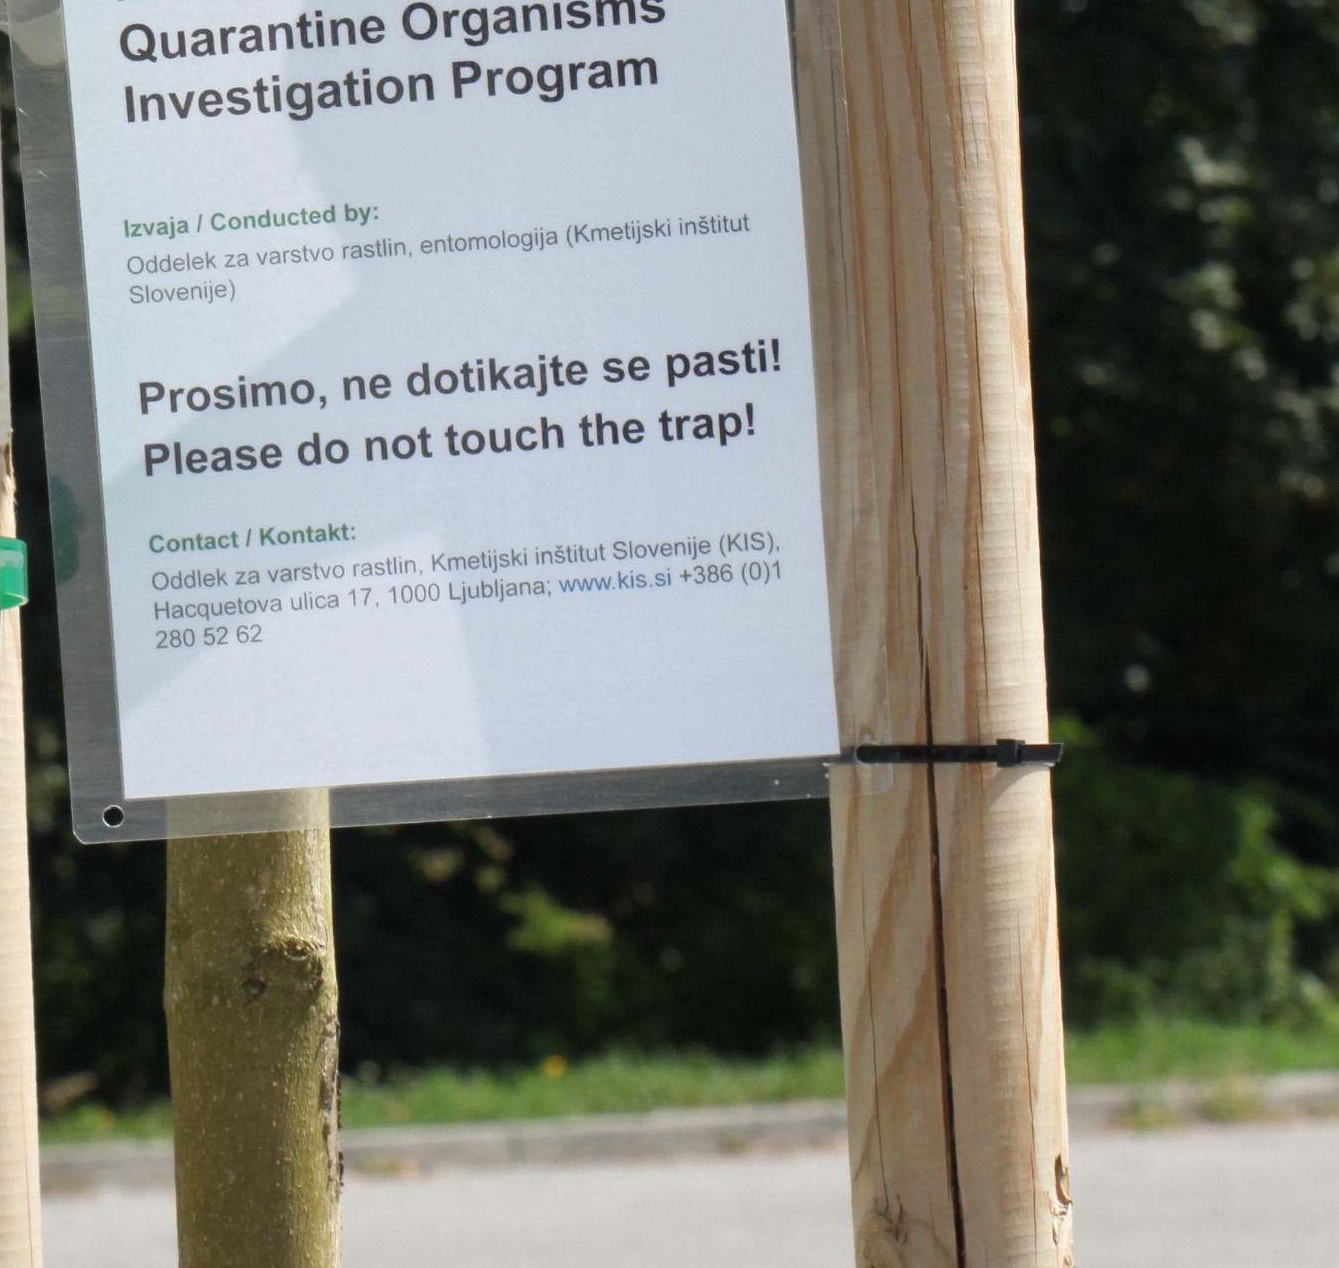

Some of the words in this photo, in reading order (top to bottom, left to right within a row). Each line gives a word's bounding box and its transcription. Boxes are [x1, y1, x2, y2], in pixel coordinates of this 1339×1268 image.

[119, 10, 386, 63] Quarantine
[124, 67, 435, 123] Investigation
[451, 57, 658, 103] Program
[123, 216, 190, 240] Izvaja
[196, 213, 203, 233] /
[210, 204, 337, 232] Conducted
[344, 203, 379, 227] by:
[126, 251, 218, 275] Oddelek
[224, 252, 250, 269] za
[256, 245, 335, 266] varstvo
[342, 237, 413, 260] rastlin,
[420, 226, 559, 255] entomologija
[566, 218, 672, 249] (Kmetijski
[678, 213, 751, 236] inštitut
[129, 278, 236, 305] Slovenije)
[138, 375, 327, 415] Prosimo,
[342, 373, 392, 401] ne
[406, 354, 589, 398] dotikajte
[602, 355, 651, 384] se
[666, 338, 781, 388] pasti!
[143, 441, 283, 477] Please
[297, 432, 350, 467] do
[365, 426, 433, 462] not
[444, 416, 565, 457] touch
[578, 412, 646, 448] the
[658, 402, 755, 447] trap!
[148, 531, 240, 554] Contact
[245, 528, 252, 548] /
[259, 523, 356, 547] Kontakt:
[151, 568, 229, 591] Oddlek
[235, 569, 261, 586] za
[266, 562, 345, 583] varstvo
[352, 556, 423, 578] rastlin,
[431, 547, 528, 574] Kmetijski
[535, 543, 606, 566] inštitut
[612, 536, 712, 561] Slovenije
[719, 531, 780, 558] (KIS),
[153, 597, 283, 622] Hacquetova
[290, 591, 340, 612] ulica
[348, 587, 379, 608] 17,
[388, 582, 441, 604] 1000
[448, 579, 552, 605] Ljubljana;
[558, 567, 672, 594] www.kis.si
[679, 563, 734, 585] +386
[741, 560, 781, 586] (0)1
[155, 628, 196, 650] 280
[203, 626, 229, 646] 52
[236, 623, 263, 644] 62
